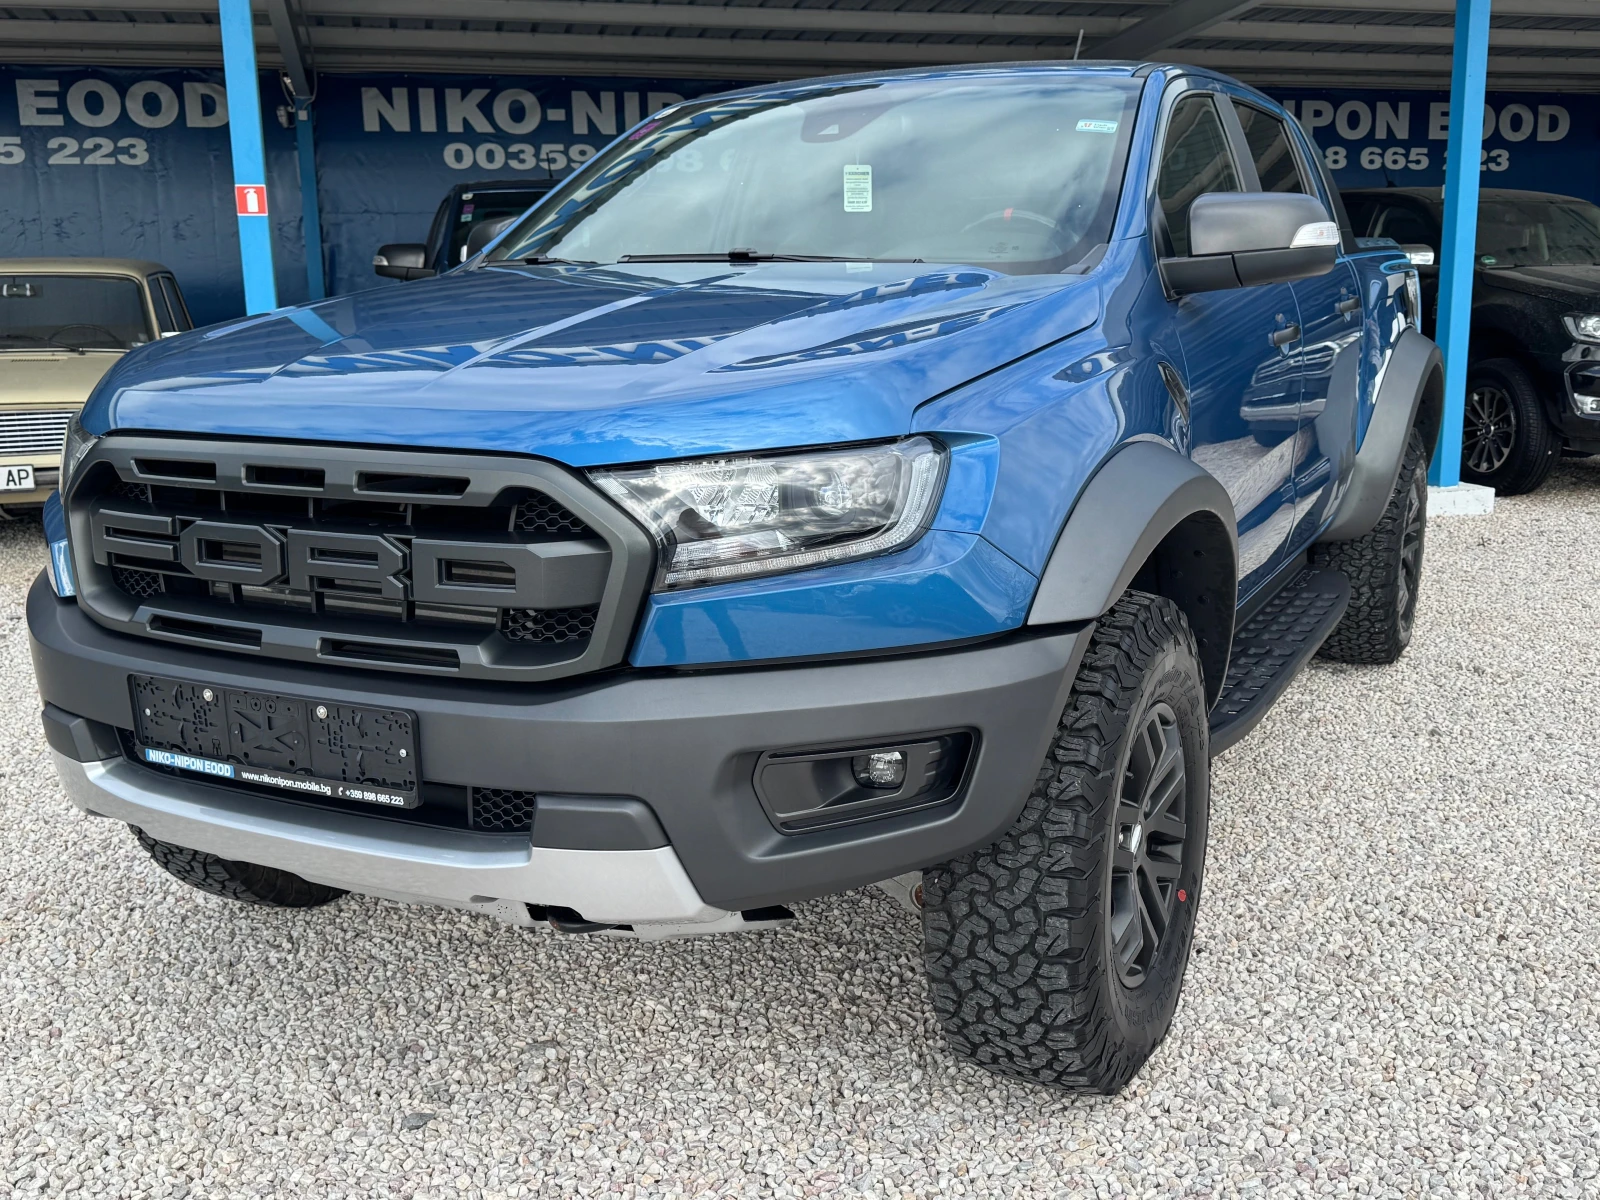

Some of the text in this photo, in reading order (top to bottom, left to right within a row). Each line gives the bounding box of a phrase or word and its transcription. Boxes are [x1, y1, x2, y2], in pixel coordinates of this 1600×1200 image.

[15, 78, 229, 128] EOOD
[47, 136, 150, 166] 223
[443, 142, 597, 171] 00359
[1360, 146, 1430, 170] 665
[6, 468, 30, 487] AP
[92, 507, 550, 611] FORD
[149, 749, 231, 777] NIKO-NIPON EOOD
[241, 771, 404, 806] www.nikonipon.mobile.bg +359 898 665 223
